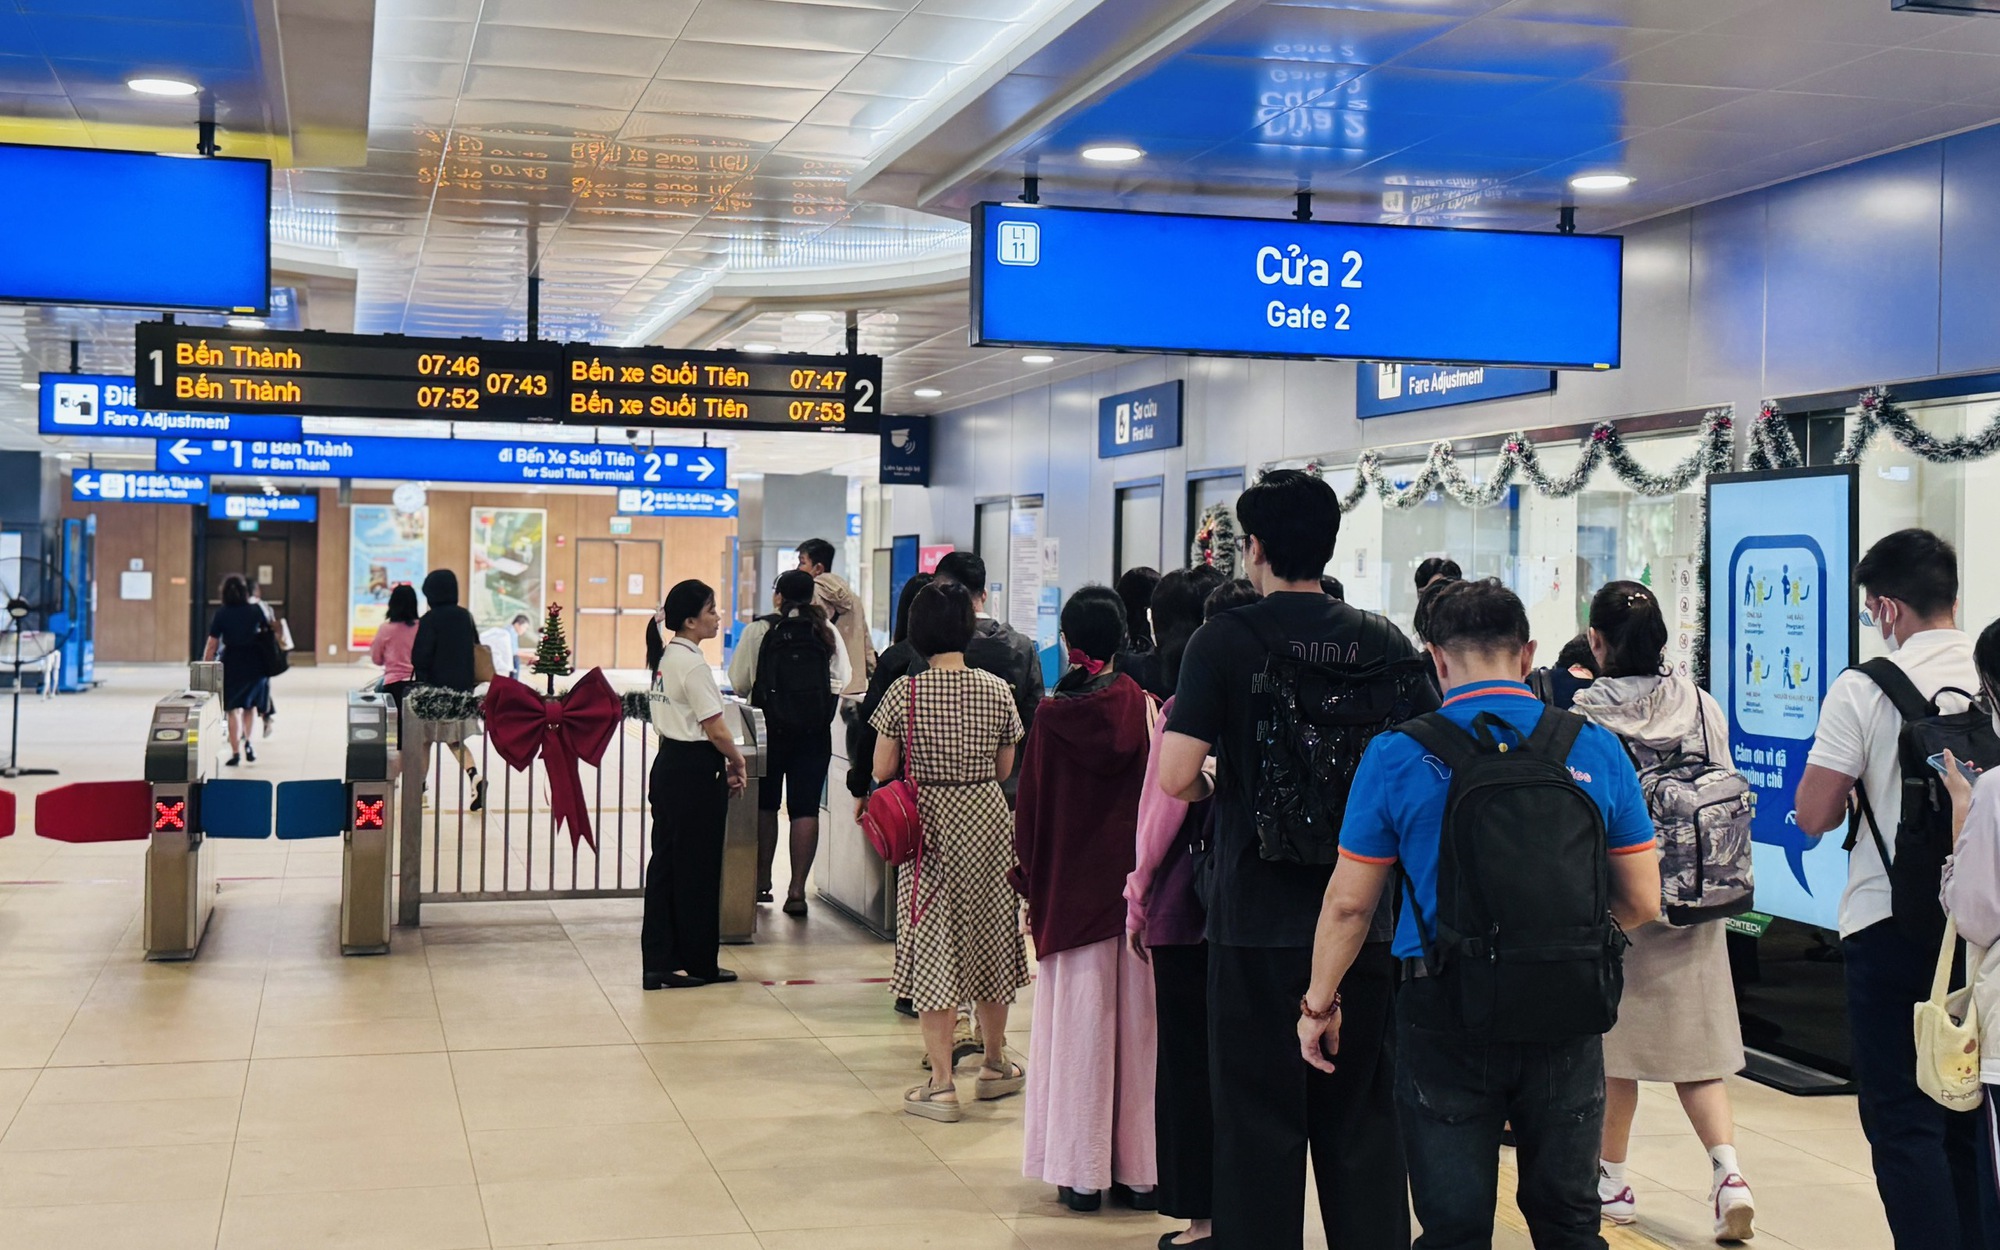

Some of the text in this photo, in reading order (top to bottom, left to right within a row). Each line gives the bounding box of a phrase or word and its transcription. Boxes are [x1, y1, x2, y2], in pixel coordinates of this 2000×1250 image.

[1012, 227, 1026, 240] L1
[1012, 242, 1026, 260] 11
[1256, 243, 1363, 289] Cửa 2
[1266, 300, 1351, 331] Gate 2
[176, 339, 302, 370] Bến Thành
[417, 353, 480, 377] 07:46
[149, 349, 164, 387] 1
[571, 356, 750, 388] Bến xe Suối Tiên
[790, 368, 848, 391] 07:47
[175, 372, 302, 403] Bến Thành
[486, 372, 548, 396] 07:43
[1408, 366, 1484, 396] Fare Adjustment
[416, 386, 480, 410] 07:52
[570, 388, 749, 419] Bến xe Suối Tiên
[853, 378, 875, 413] 2
[103, 410, 231, 431] Fare Adjustment
[788, 400, 846, 422] 07:53
[303, 440, 354, 458] Thành
[270, 457, 294, 471] Ben
[294, 457, 331, 472] Thanh
[643, 452, 662, 483] 2
[640, 489, 656, 513] 2
